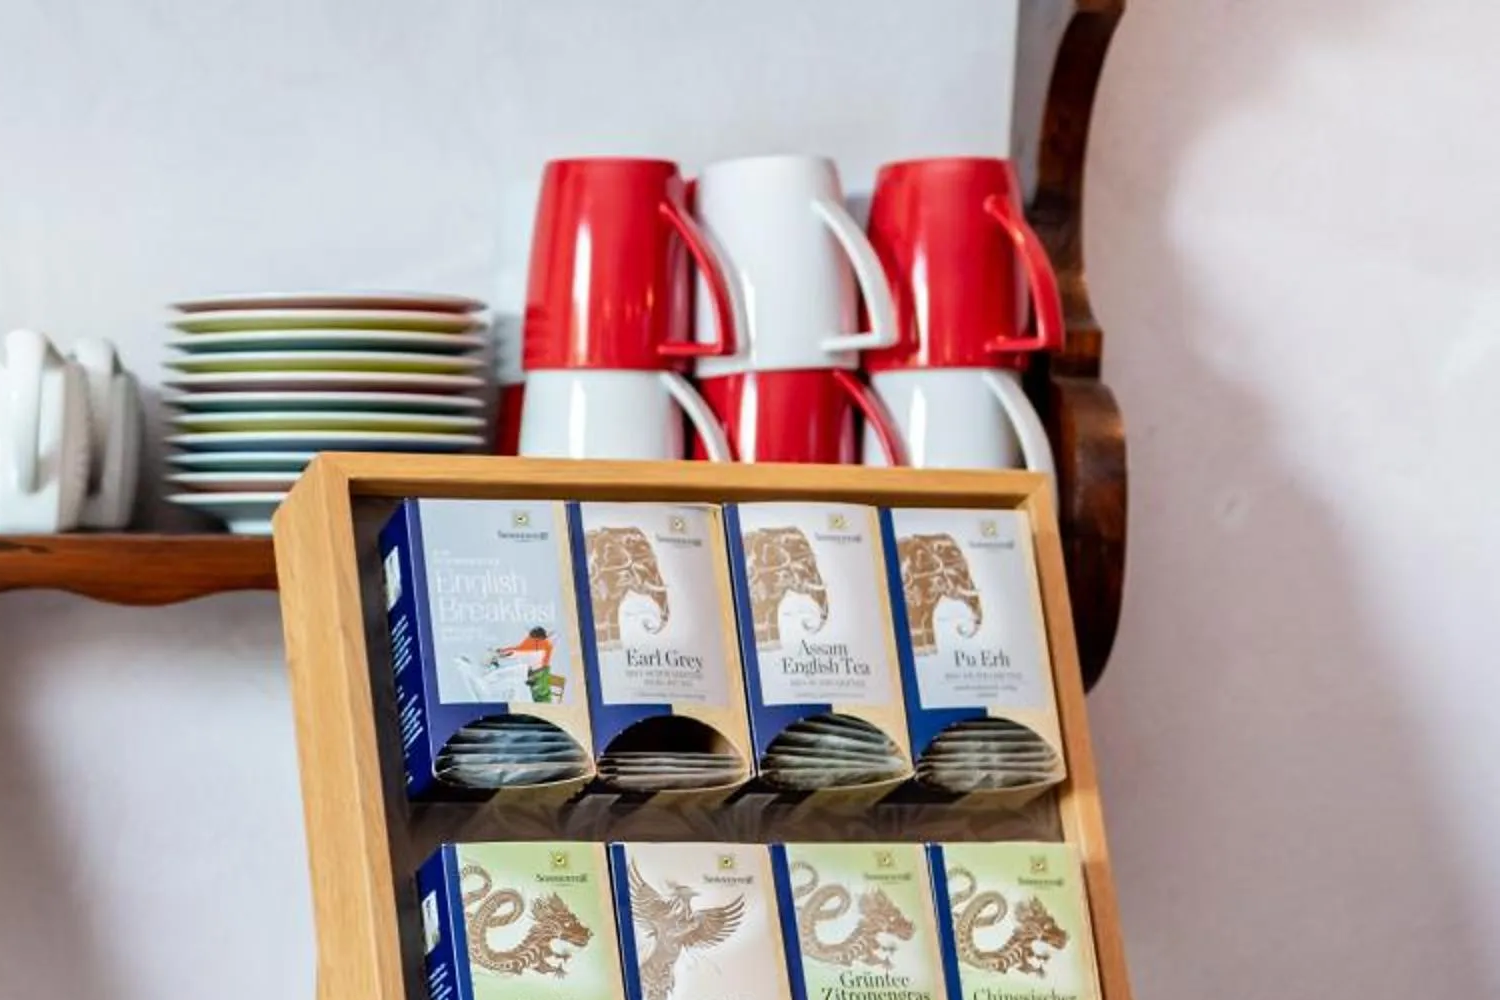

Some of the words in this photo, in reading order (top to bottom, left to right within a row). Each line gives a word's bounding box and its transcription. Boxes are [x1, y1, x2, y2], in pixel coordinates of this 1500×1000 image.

[436, 568, 527, 598] English
[799, 639, 848, 656] Assam
[627, 649, 662, 668] Earl
[664, 650, 704, 673] Grey
[781, 657, 839, 676] English
[843, 657, 871, 675] Tea
[954, 650, 977, 668] Pu
[981, 650, 1010, 668] Erh
[839, 971, 910, 988] Grüntee
